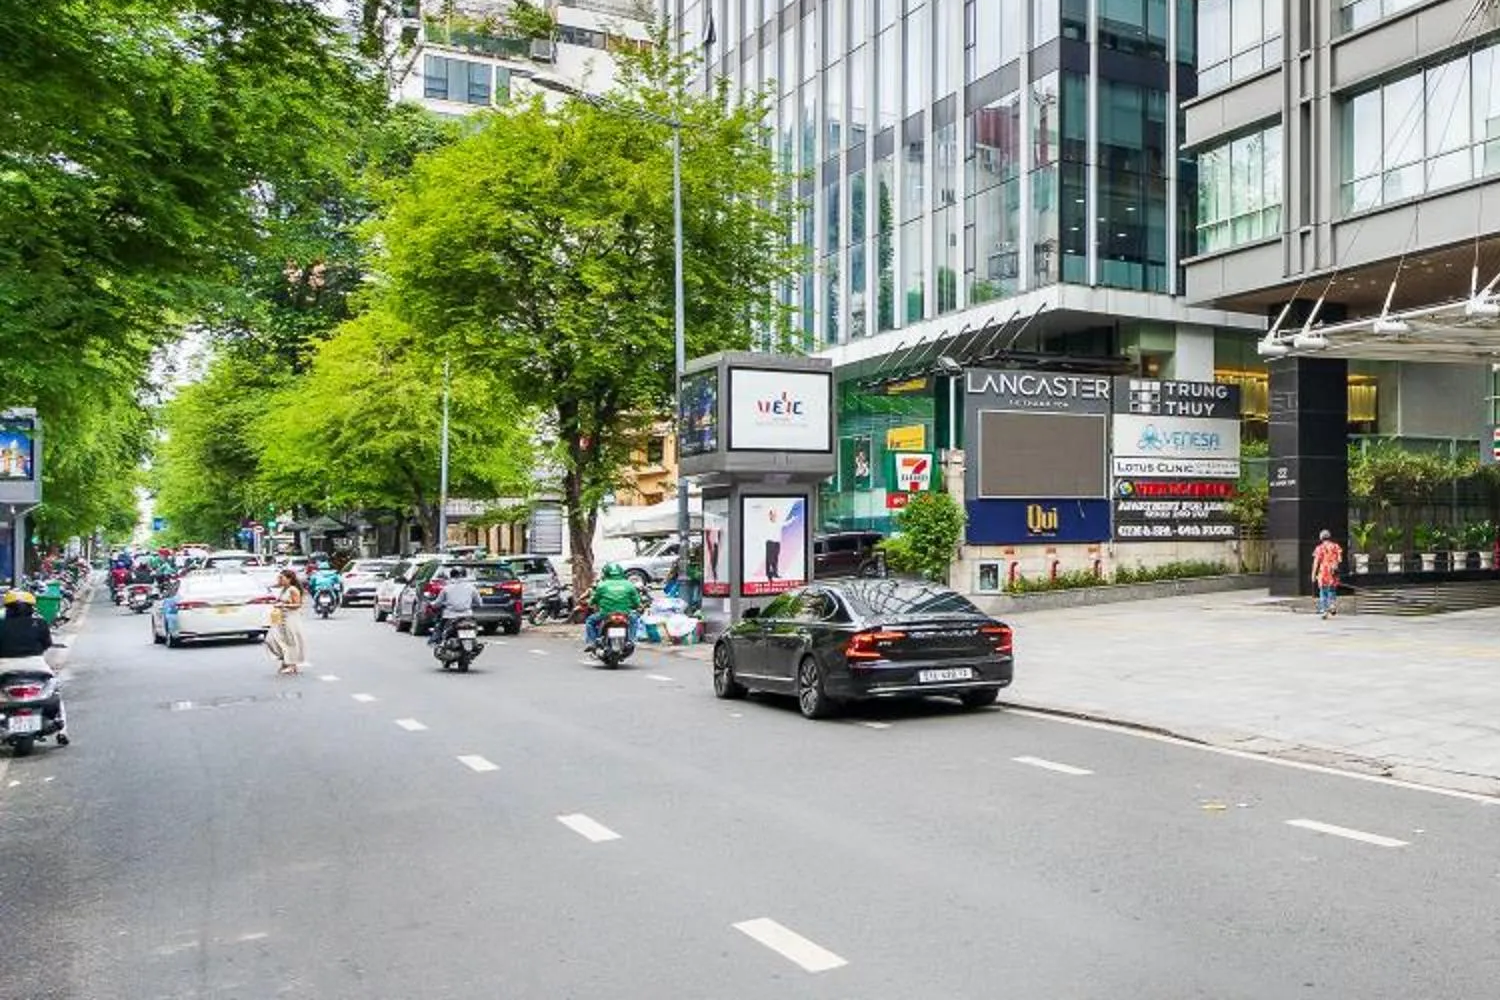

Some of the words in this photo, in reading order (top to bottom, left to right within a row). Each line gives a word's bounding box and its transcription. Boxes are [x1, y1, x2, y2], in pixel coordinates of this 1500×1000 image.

[967, 371, 1110, 399] LANCASTER
[1164, 382, 1229, 399] TRUNG
[1165, 401, 1215, 416] THUY
[1027, 504, 1058, 533] Qui
